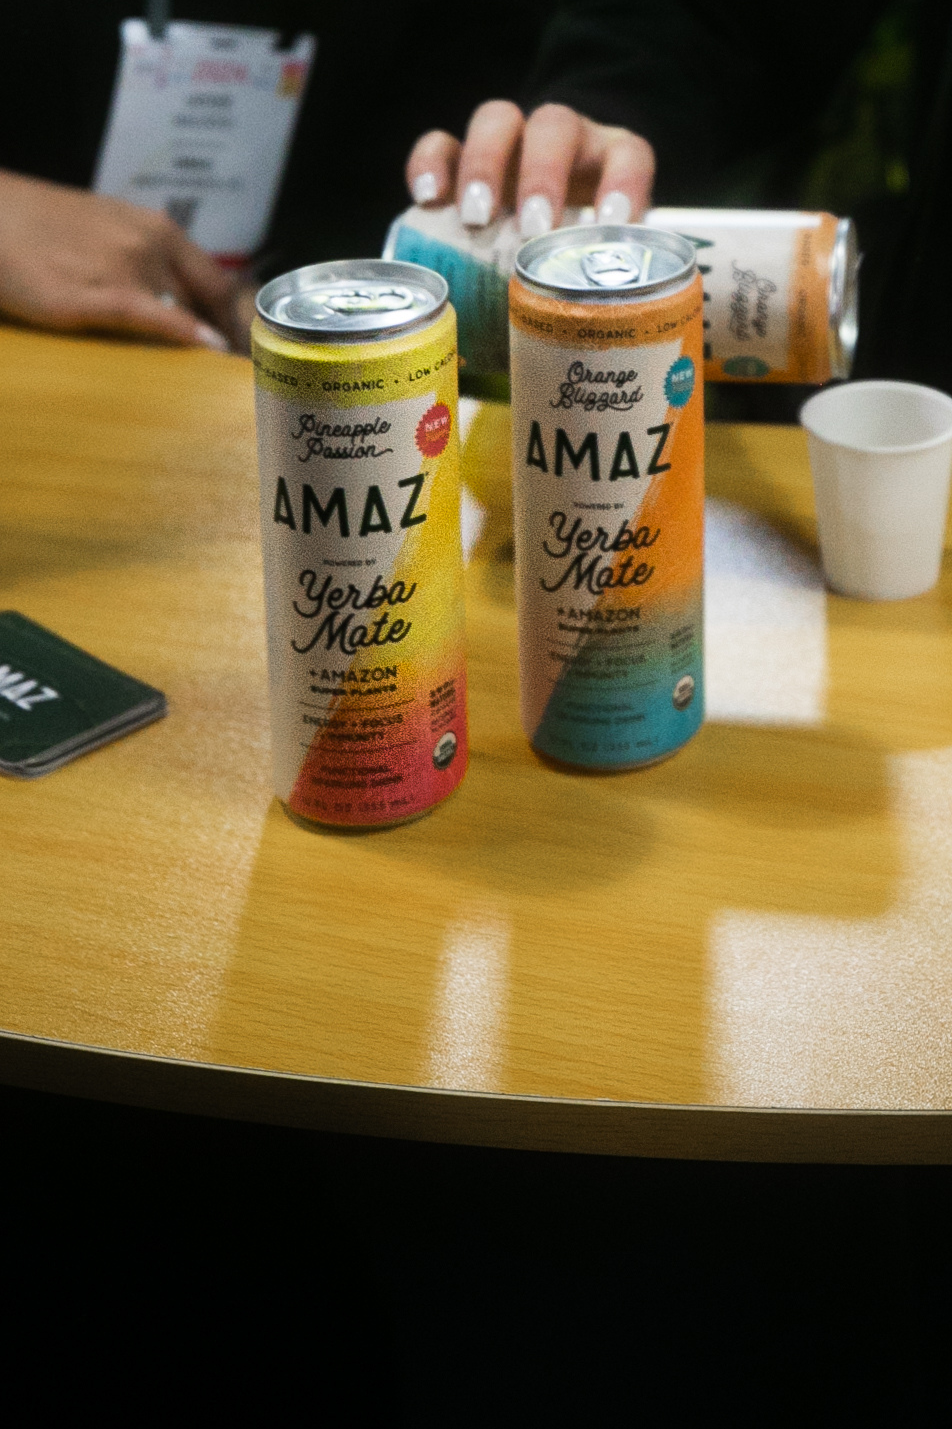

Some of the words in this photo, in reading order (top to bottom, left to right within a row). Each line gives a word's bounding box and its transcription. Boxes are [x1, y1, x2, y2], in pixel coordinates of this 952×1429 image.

[577, 328, 637, 340] ORGANIC
[322, 379, 385, 392] ORGANIC
[408, 366, 430, 382] LOW
[567, 360, 639, 388] Orange
[549, 382, 644, 412] Blizzard
[291, 413, 392, 444] Pineapple
[298, 437, 394, 463] Passion
[526, 419, 673, 482] AMAZ
[274, 474, 427, 538] AMAZ
[542, 511, 661, 559] Yerba
[539, 552, 656, 596] Mate
[292, 569, 418, 618] Yerba
[568, 606, 641, 623] AMAZON
[291, 610, 412, 655] Mate
[320, 665, 398, 683] AMAZON
